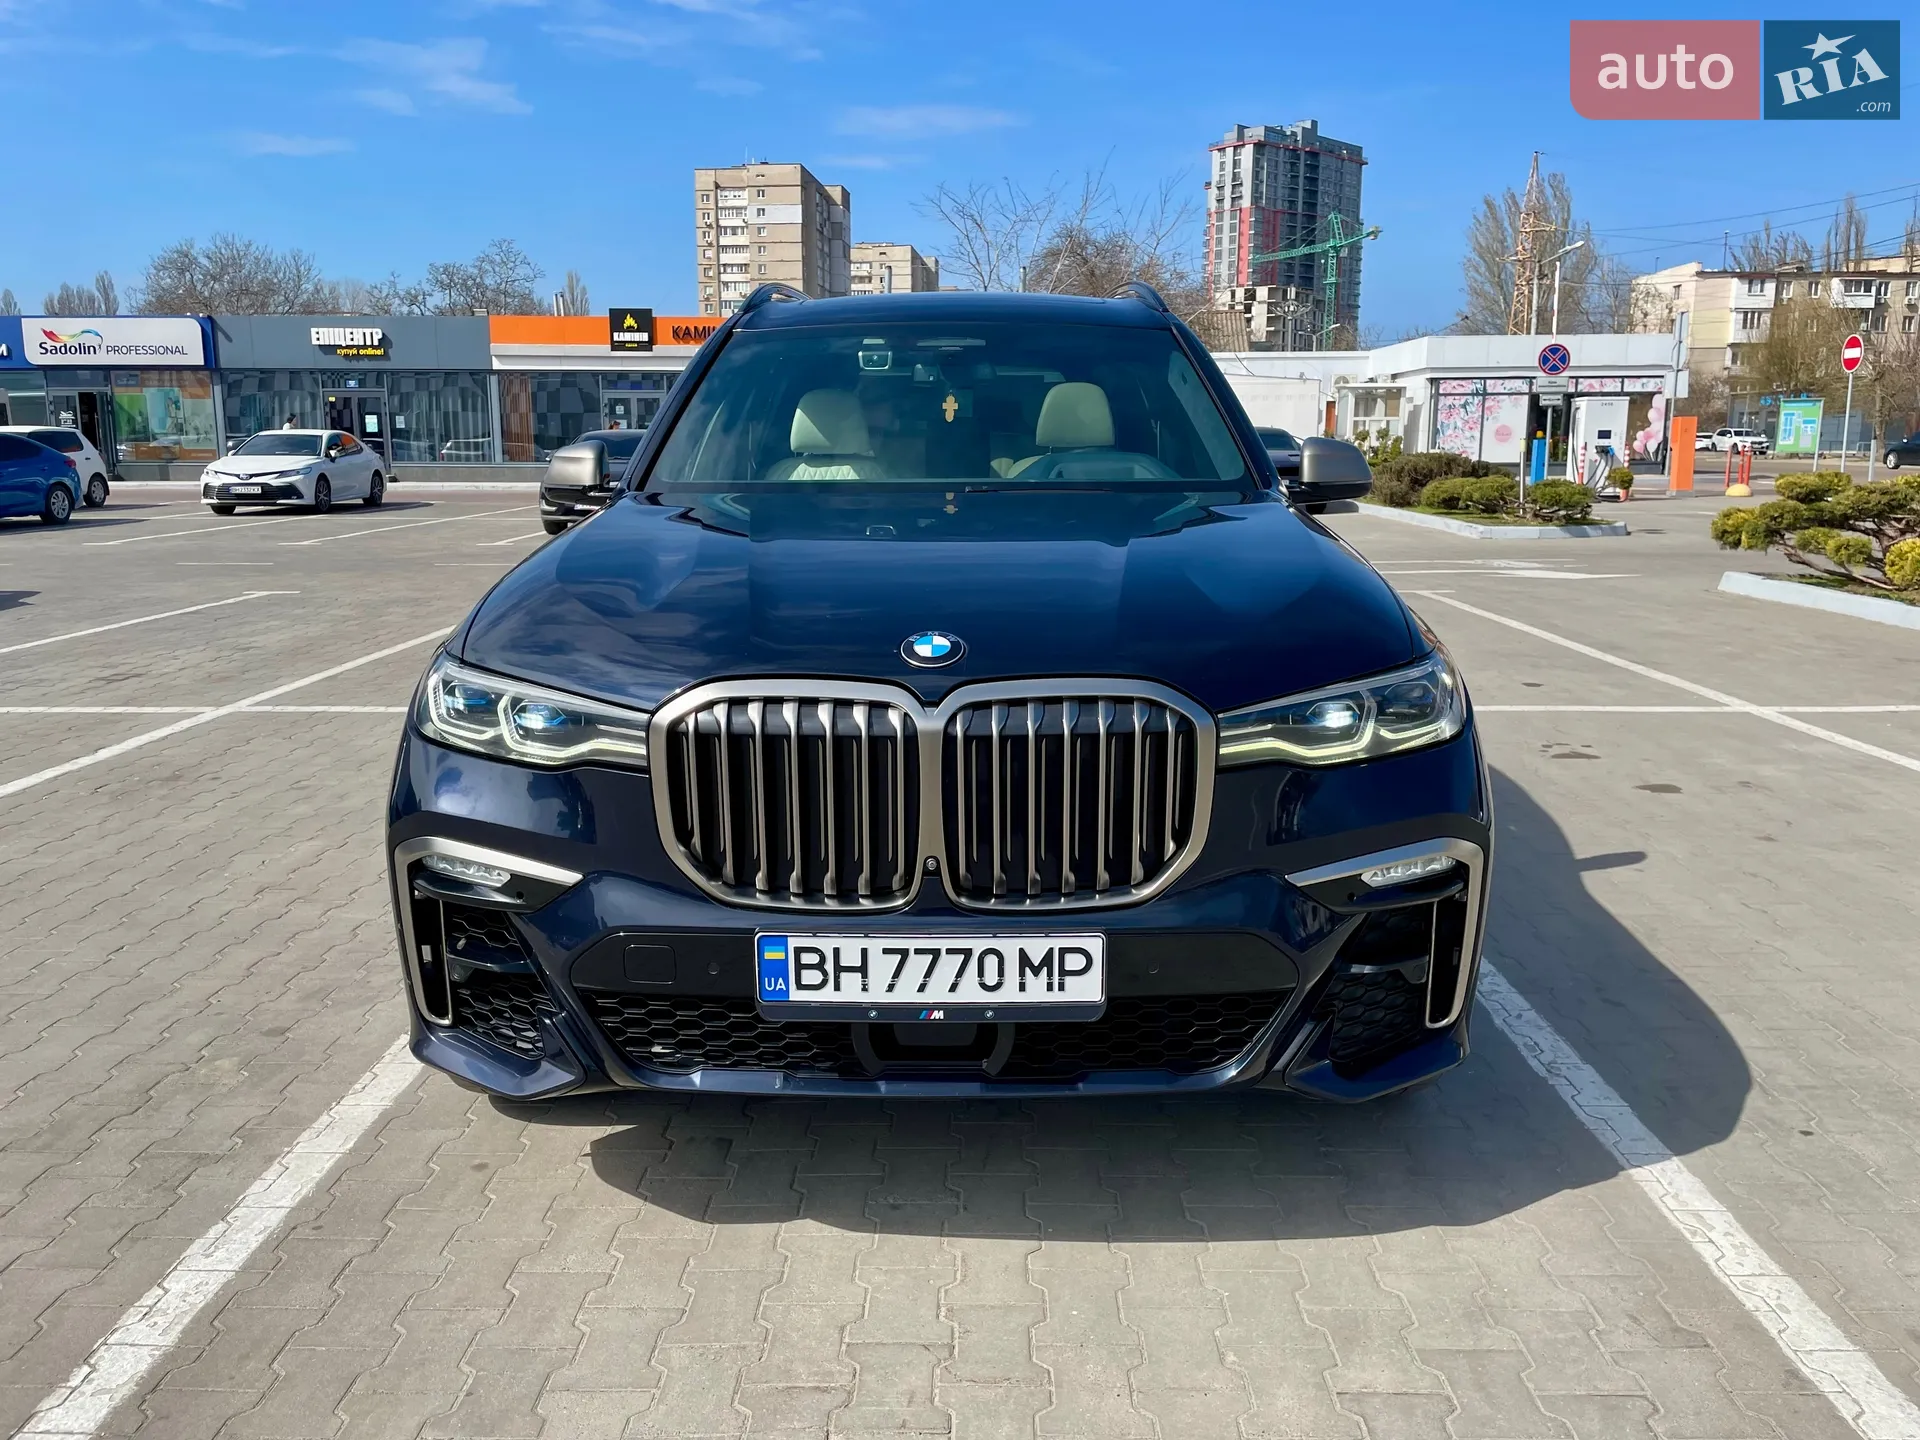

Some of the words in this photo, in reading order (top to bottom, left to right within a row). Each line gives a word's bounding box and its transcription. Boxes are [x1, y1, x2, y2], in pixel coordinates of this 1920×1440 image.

[310, 327, 383, 347] ЕПІЦЕНТР
[39, 341, 97, 356] Sadolin
[106, 345, 188, 356] PROFESSIONAL
[336, 347, 358, 357] купуй
[359, 347, 385, 356] online!
[793, 946, 869, 992] BH
[882, 947, 1005, 992] 7770
[1018, 946, 1093, 992] MP
[764, 977, 787, 991] UA
